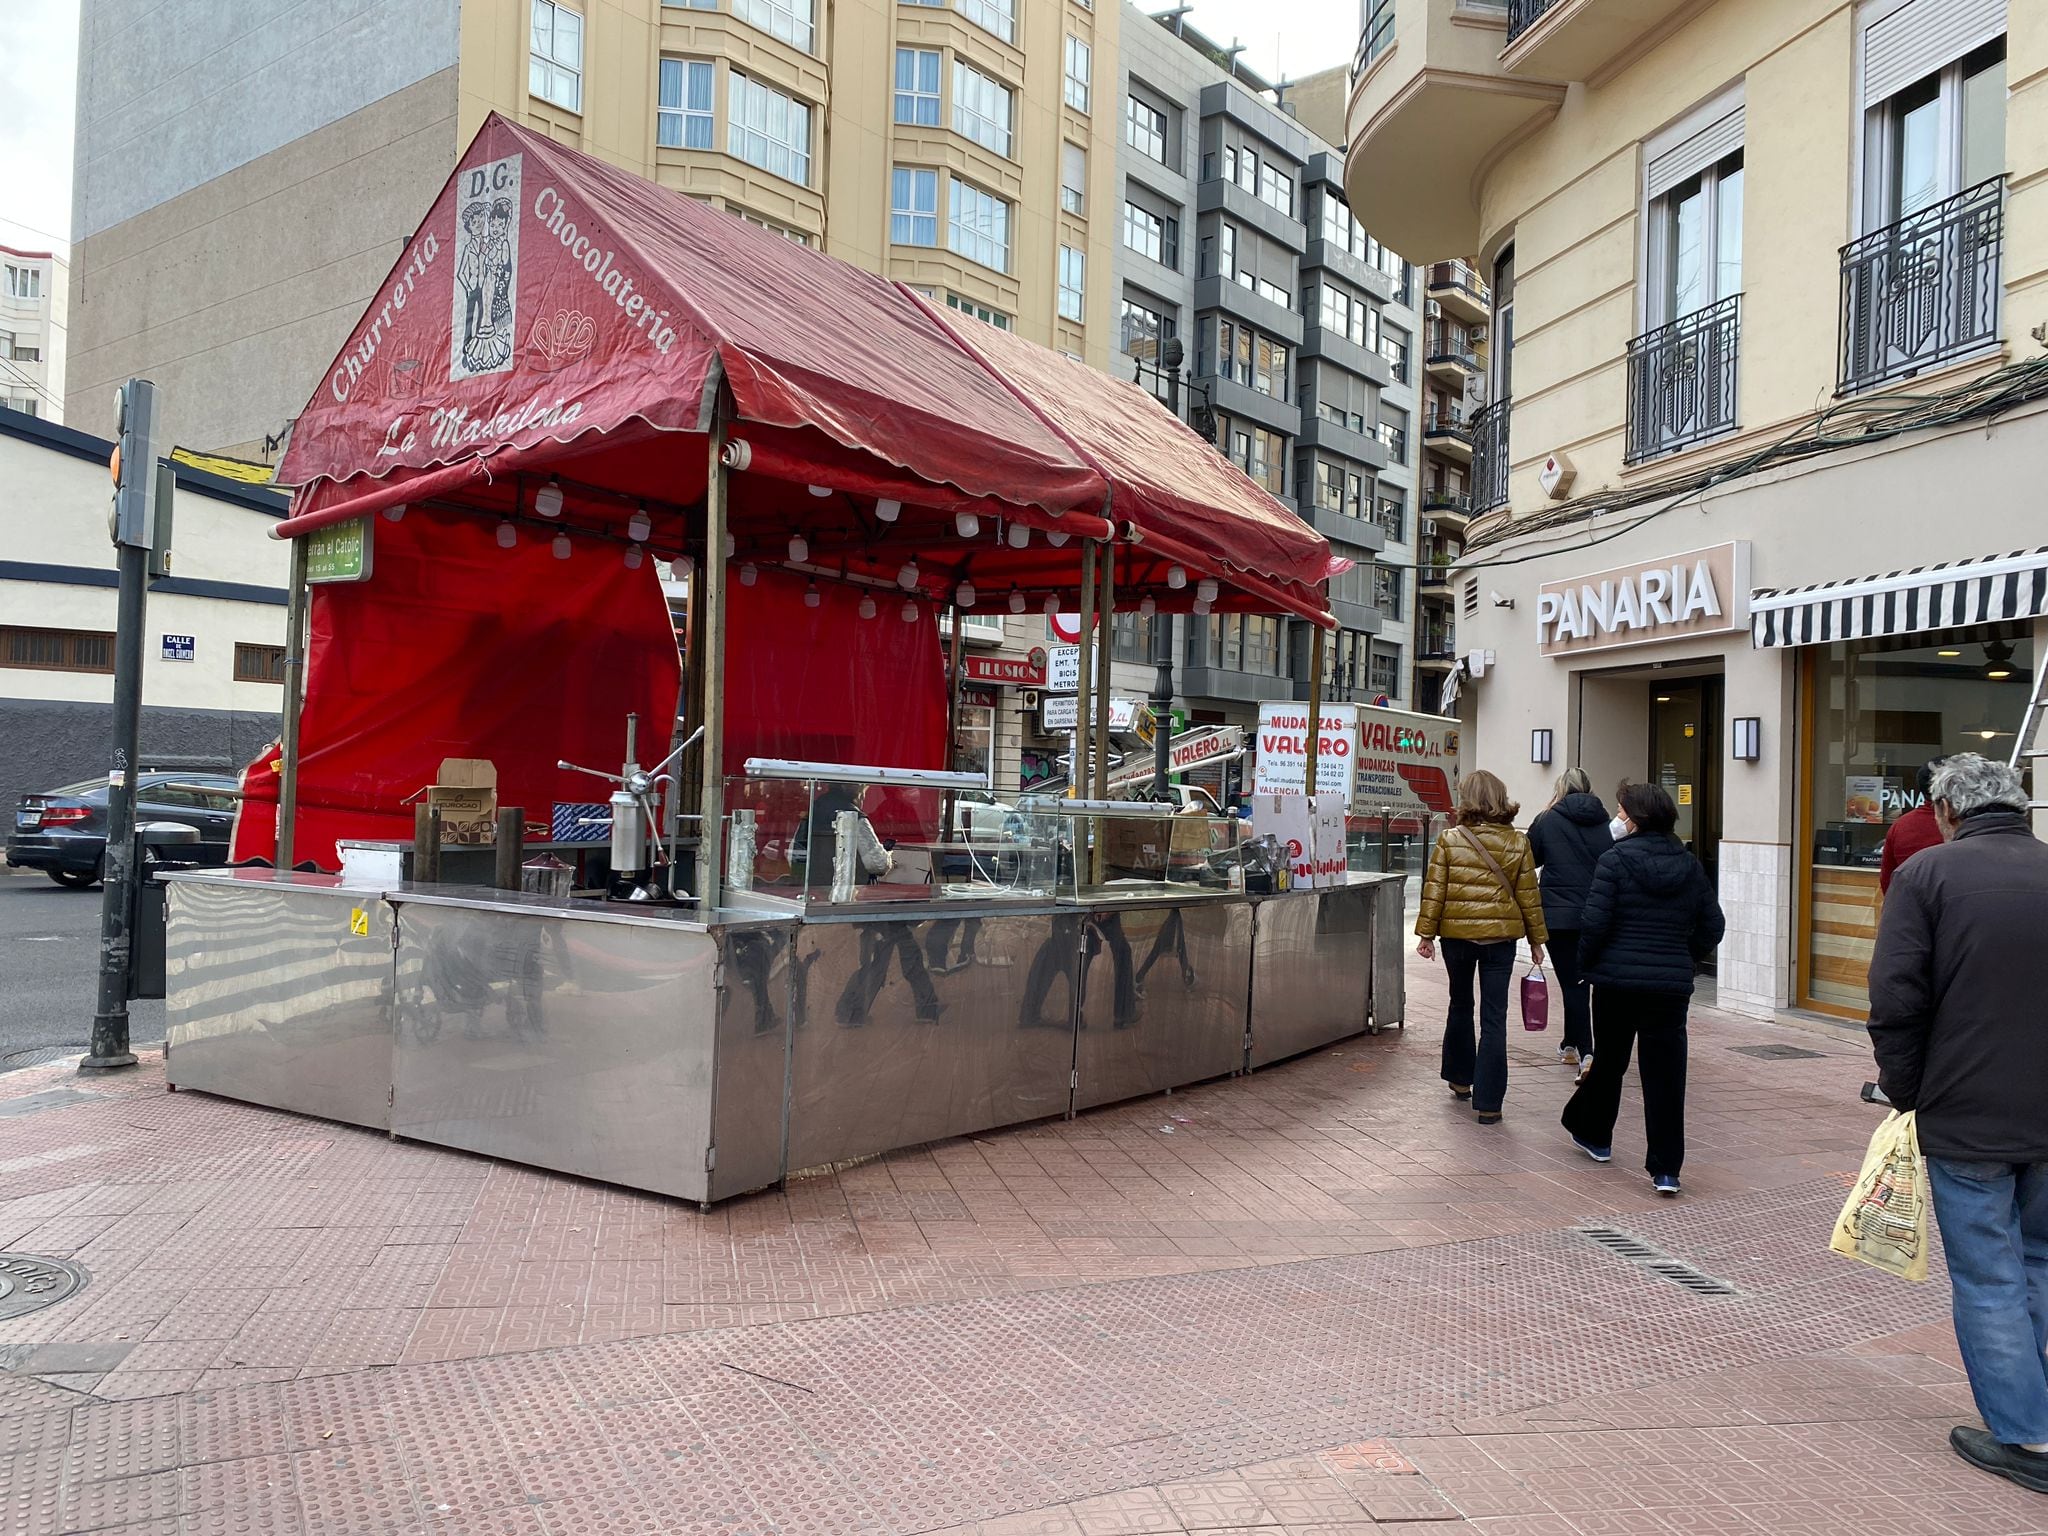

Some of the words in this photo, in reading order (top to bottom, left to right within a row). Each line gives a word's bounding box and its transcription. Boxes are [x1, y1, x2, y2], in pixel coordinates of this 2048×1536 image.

[470, 162, 514, 199] D.G.
[534, 187, 677, 354] Chocolatería
[332, 232, 440, 402] Churrería
[376, 416, 416, 458] La
[429, 397, 584, 449] Madrileña
[327, 538, 334, 555] el
[328, 562, 336, 571] 55
[1537, 560, 1721, 644] PANARIA
[166, 636, 191, 644] CALLE
[1057, 648, 1079, 656] EXCEP
[979, 662, 1039, 680] ILUSION
[1059, 670, 1077, 678] BICIS
[1271, 716, 1343, 731] MUDAZAS
[1358, 757, 1395, 773] MUDANZAS
[1358, 773, 1395, 785] TRANSPORTES
[1258, 786, 1300, 796] VALENCIA
[1356, 784, 1402, 796] INTERNACIONALES
[1880, 789, 1926, 808] PANA
